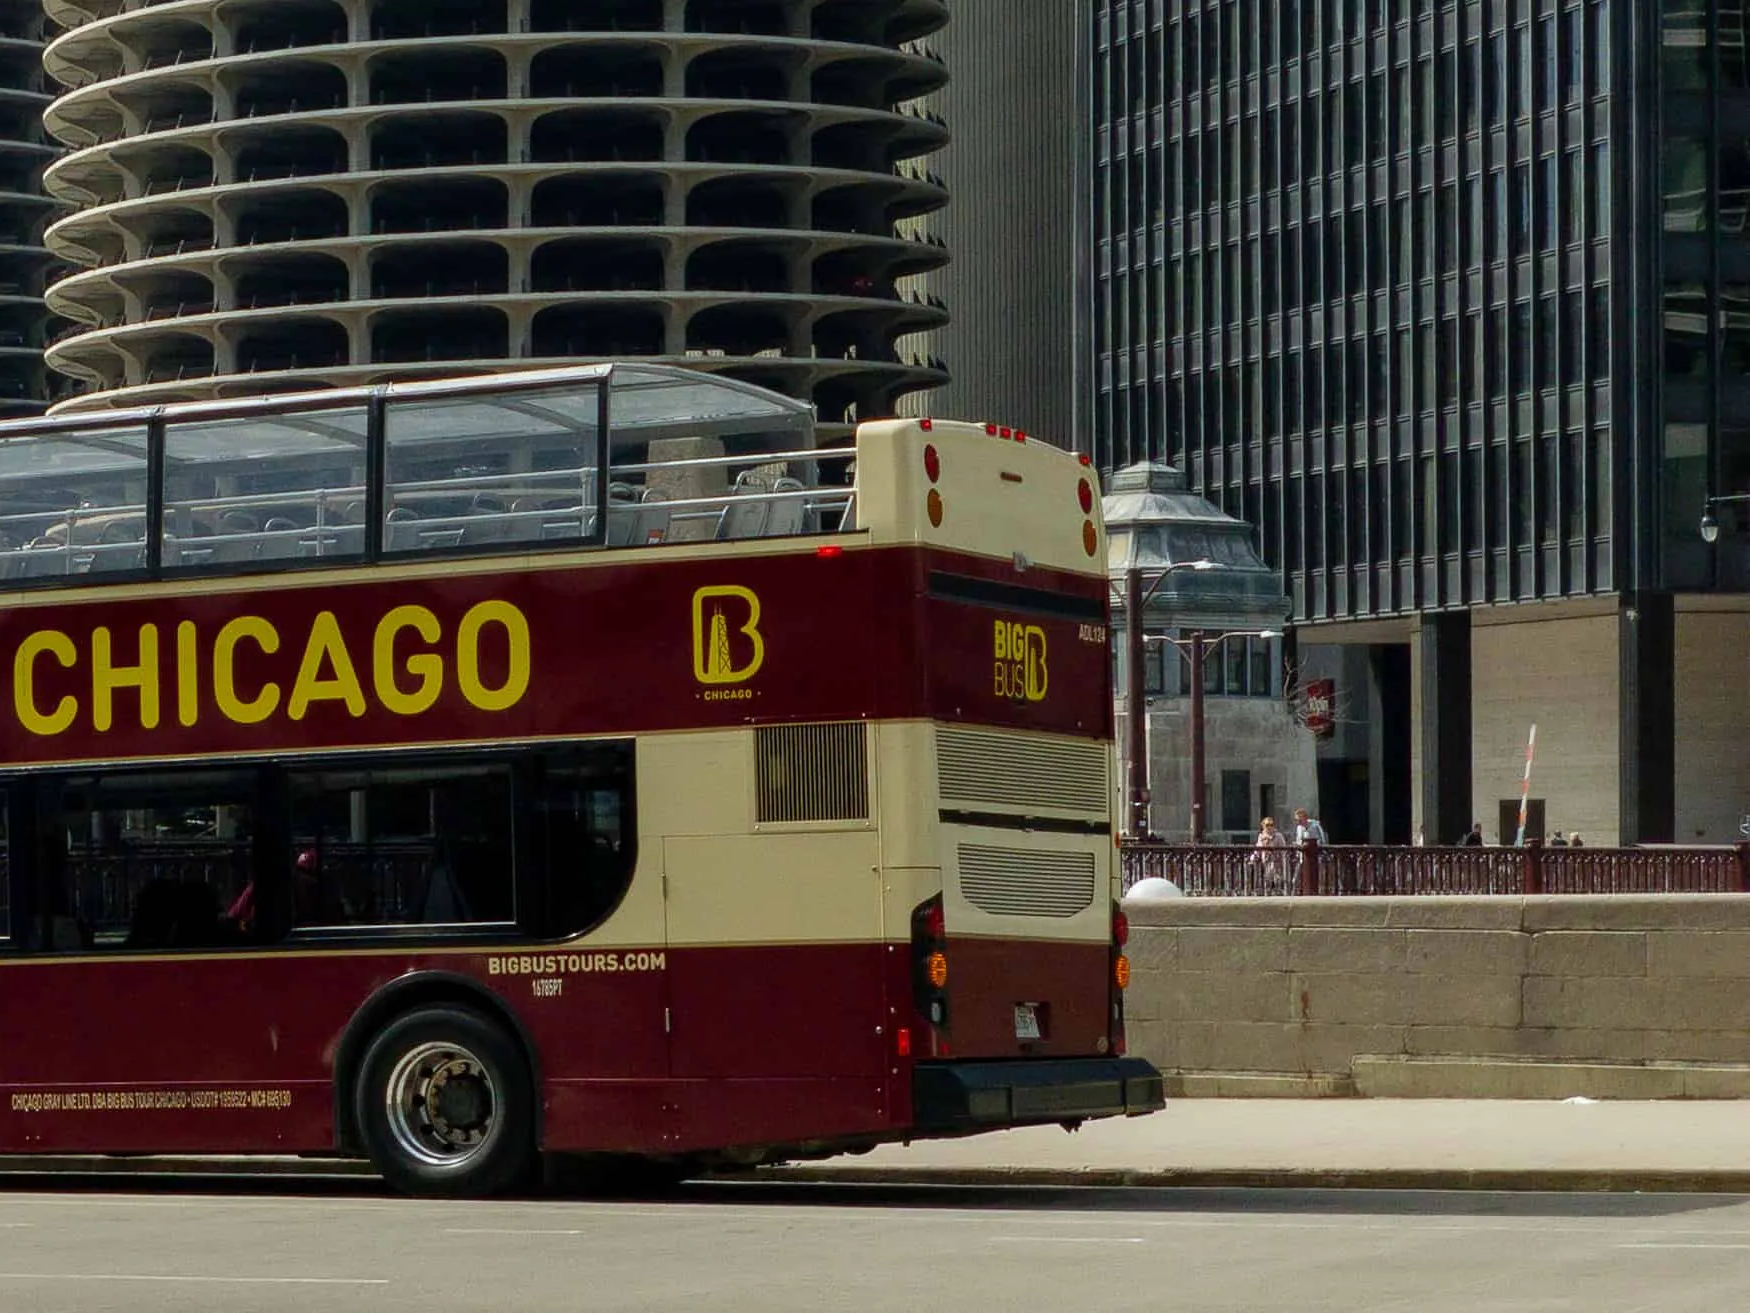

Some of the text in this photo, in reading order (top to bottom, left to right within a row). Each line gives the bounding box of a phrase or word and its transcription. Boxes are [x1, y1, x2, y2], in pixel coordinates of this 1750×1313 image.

[994, 619, 1024, 661] BIG
[1078, 623, 1106, 644] ADL124
[13, 599, 532, 737] CHICAGO
[994, 662, 1024, 698] BUS
[704, 689, 752, 701] CHICAGO
[488, 952, 666, 974] BIGBUSTOURS.COM
[532, 978, 563, 997] 16785PT
[12, 1093, 42, 1109] CHICAGO
[43, 1093, 61, 1109] GRAY
[61, 1093, 77, 1109] LINE
[107, 1092, 120, 1108] BIG
[120, 1092, 134, 1108] BUS
[155, 1091, 186, 1108] CHICAGO
